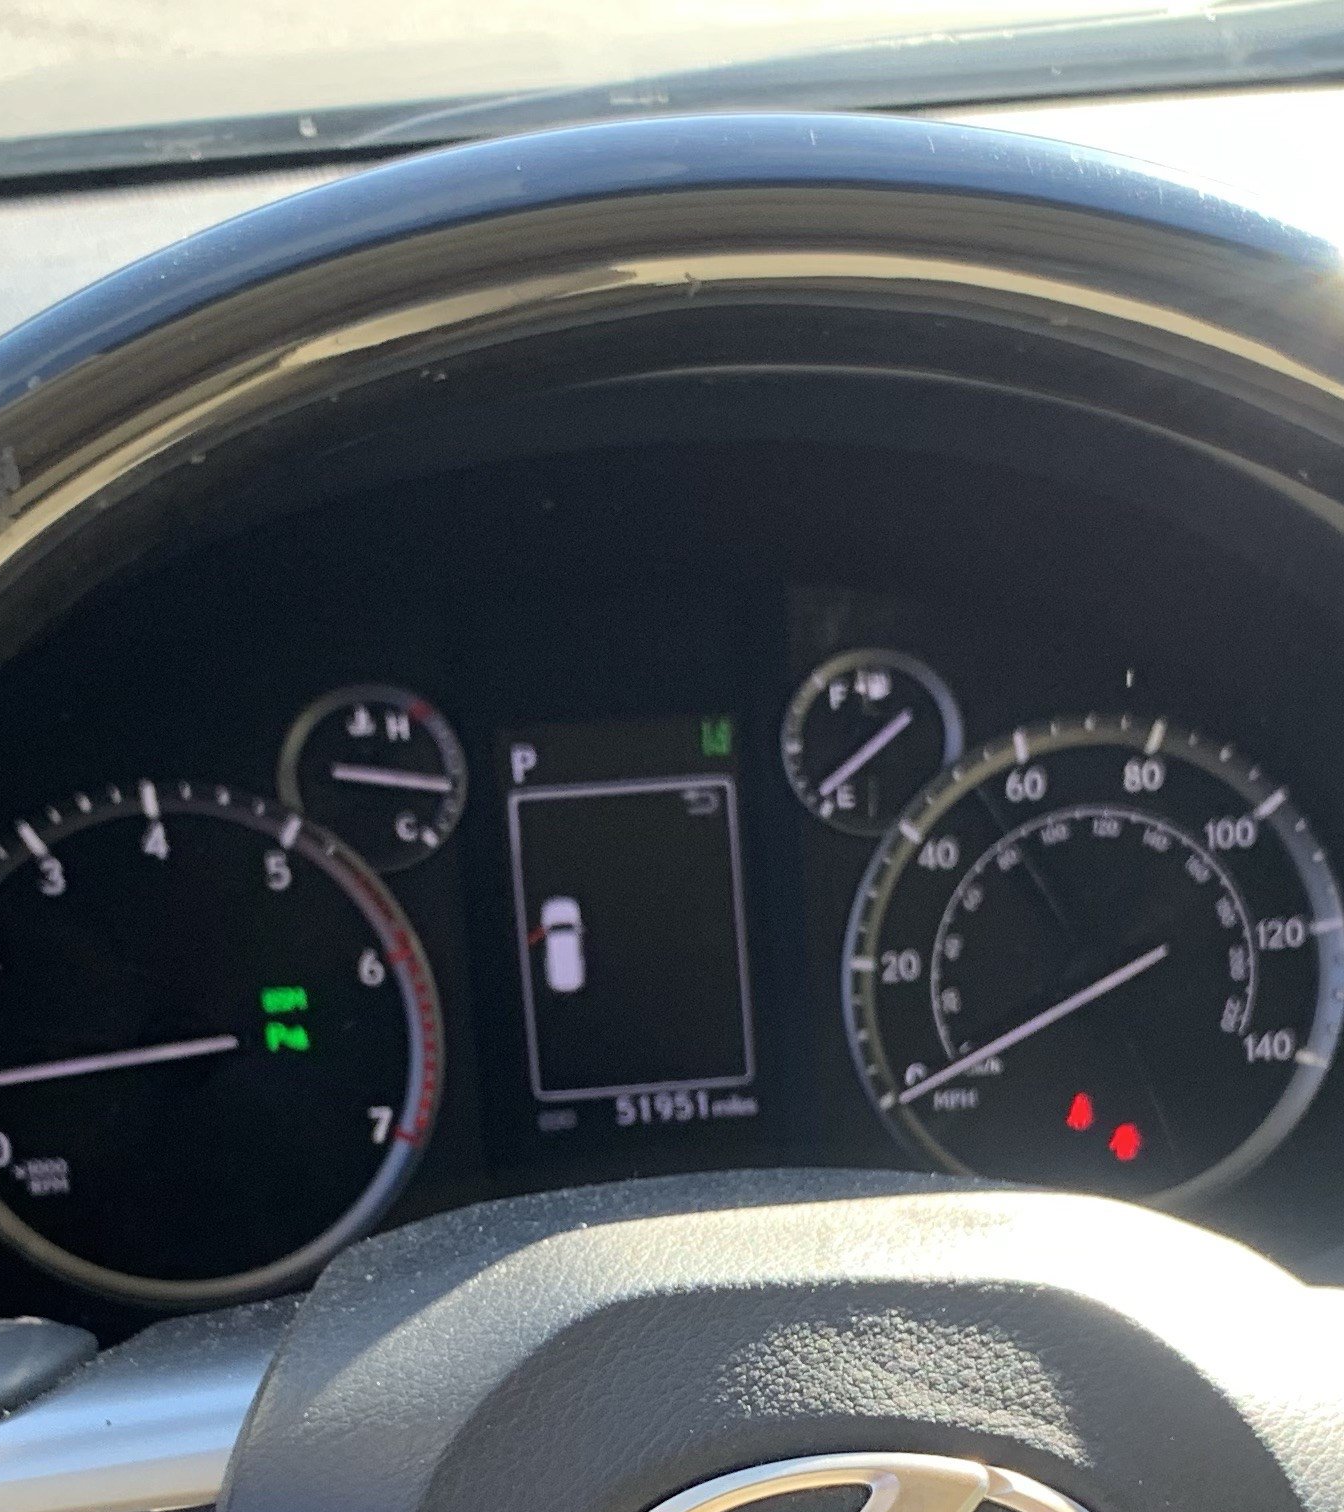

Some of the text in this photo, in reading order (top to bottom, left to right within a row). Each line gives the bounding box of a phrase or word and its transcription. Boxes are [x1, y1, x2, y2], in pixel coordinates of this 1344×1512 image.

[828, 681, 848, 711] F
[387, 713, 411, 741] H
[510, 743, 538, 784] P
[1124, 758, 1166, 792] 80
[1005, 768, 1047, 802] 60
[142, 823, 170, 860] 4
[395, 815, 418, 842] C
[1205, 816, 1256, 851] 100
[265, 850, 292, 890] 5
[916, 836, 959, 870] 40
[41, 858, 66, 896] 3
[1256, 918, 1306, 951] 120
[358, 951, 385, 986] 6
[880, 950, 921, 985] 20
[1243, 1028, 1295, 1064] 140
[368, 1106, 394, 1143] 7
[615, 1089, 709, 1127] 51951
